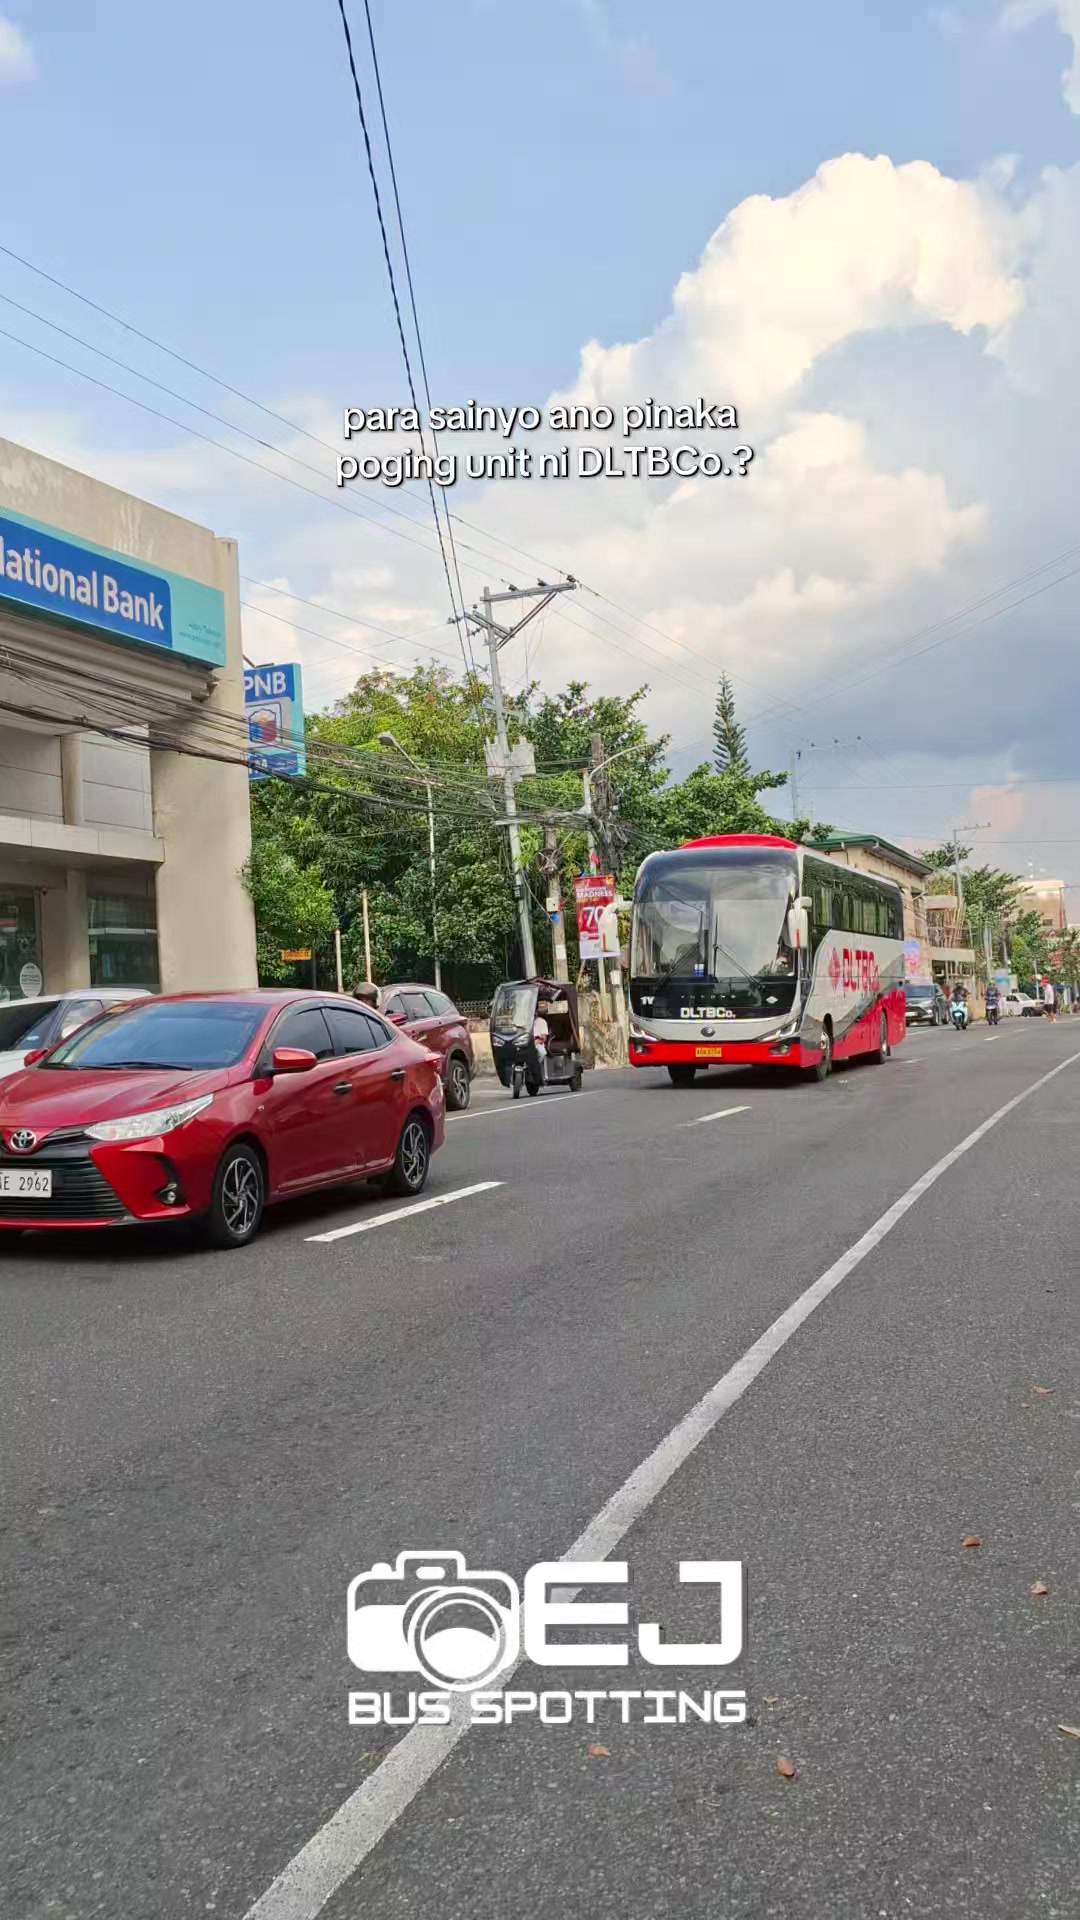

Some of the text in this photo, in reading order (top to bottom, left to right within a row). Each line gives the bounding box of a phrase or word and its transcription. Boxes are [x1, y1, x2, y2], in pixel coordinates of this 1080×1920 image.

[103, 574, 165, 631] Bank
[245, 671, 287, 697] PNB
[19, 1176, 49, 1192] 2962
